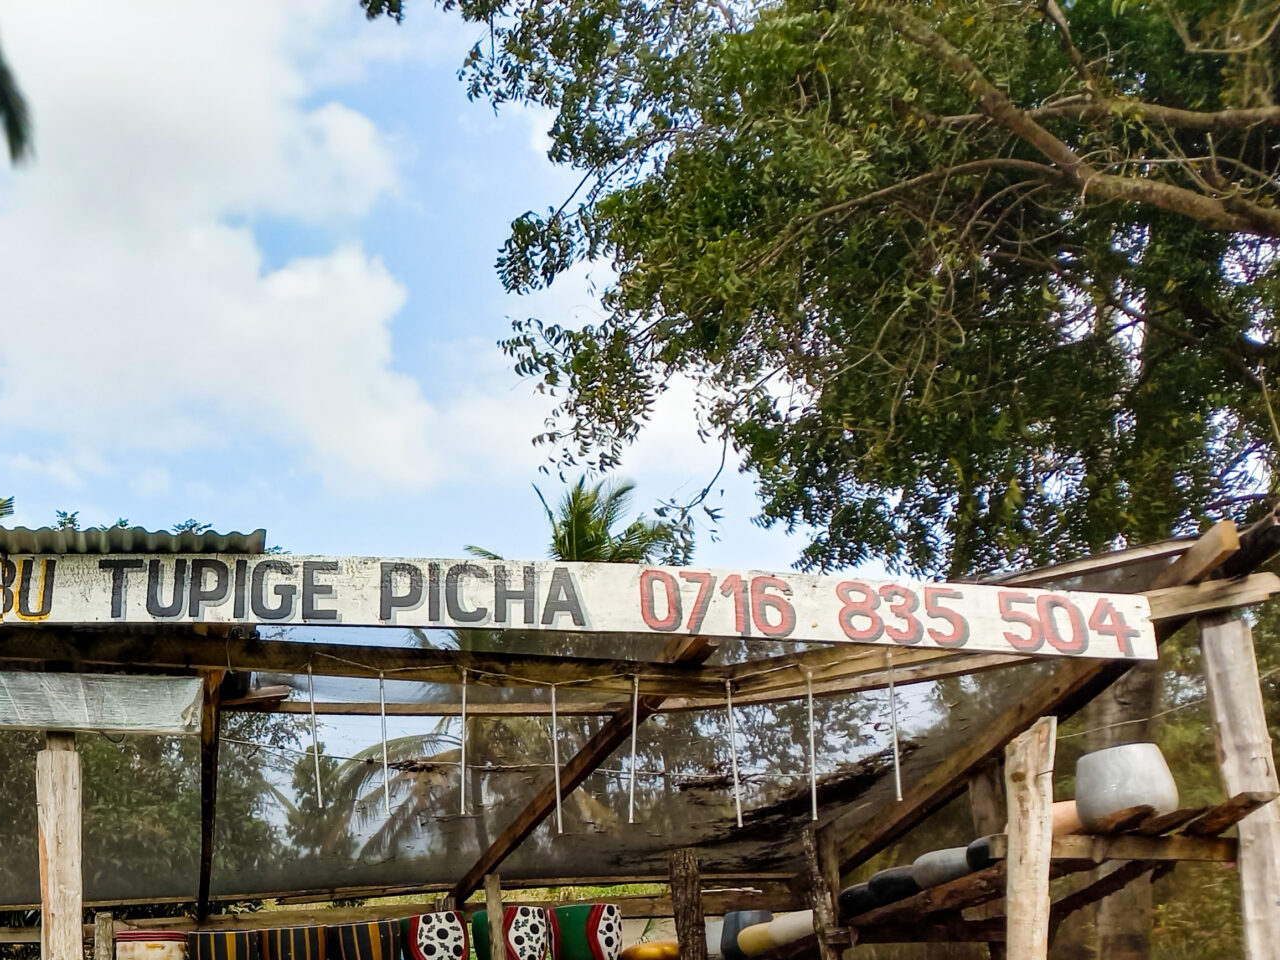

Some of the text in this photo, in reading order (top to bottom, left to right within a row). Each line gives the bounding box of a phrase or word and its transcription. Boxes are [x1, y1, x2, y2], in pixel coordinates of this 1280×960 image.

[98, 558, 342, 622] TUPIGE
[379, 561, 591, 628] PICHA
[639, 570, 797, 637] 0716
[836, 581, 969, 648] 835
[998, 590, 1140, 657] 504
